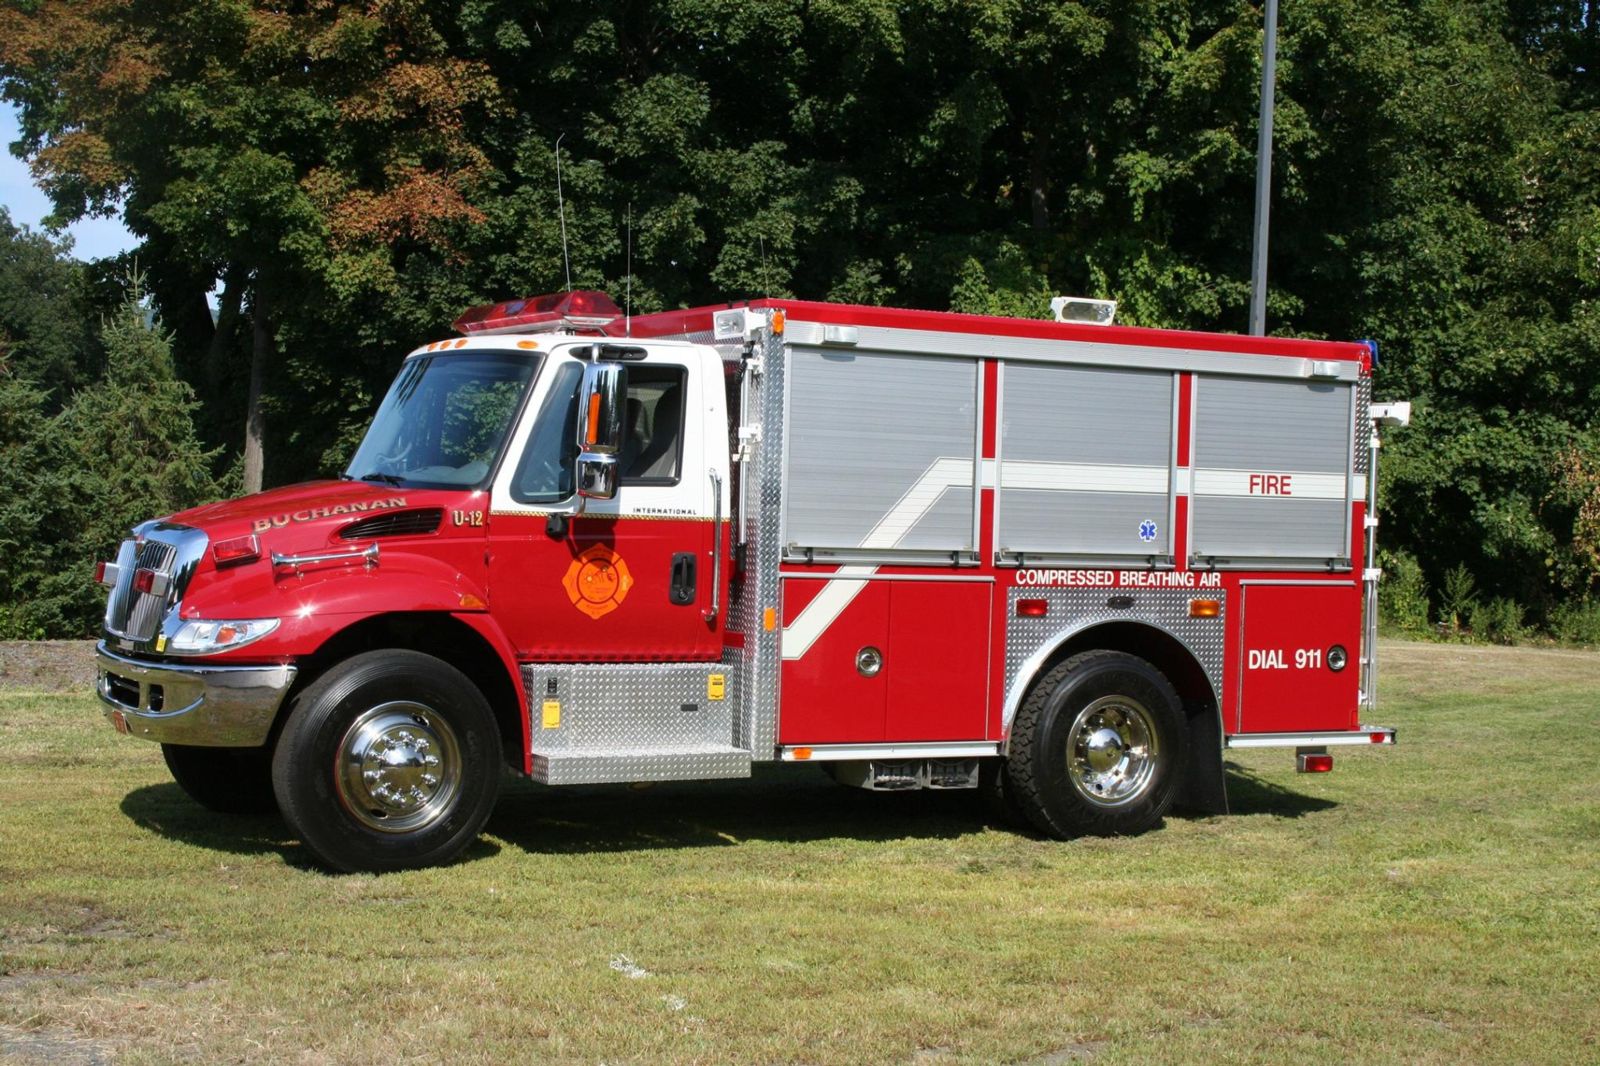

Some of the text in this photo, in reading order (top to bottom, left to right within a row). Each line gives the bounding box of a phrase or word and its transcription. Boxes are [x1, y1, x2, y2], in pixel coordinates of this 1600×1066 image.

[1249, 474, 1292, 495] FIRE
[252, 497, 408, 534] BUCHANAN
[453, 510, 484, 528] U-12
[632, 507, 697, 516] INTERNATIONAL
[1015, 569, 1221, 587] COMPRESSED BREATHING AIR
[1248, 649, 1322, 670] DIAL 911
